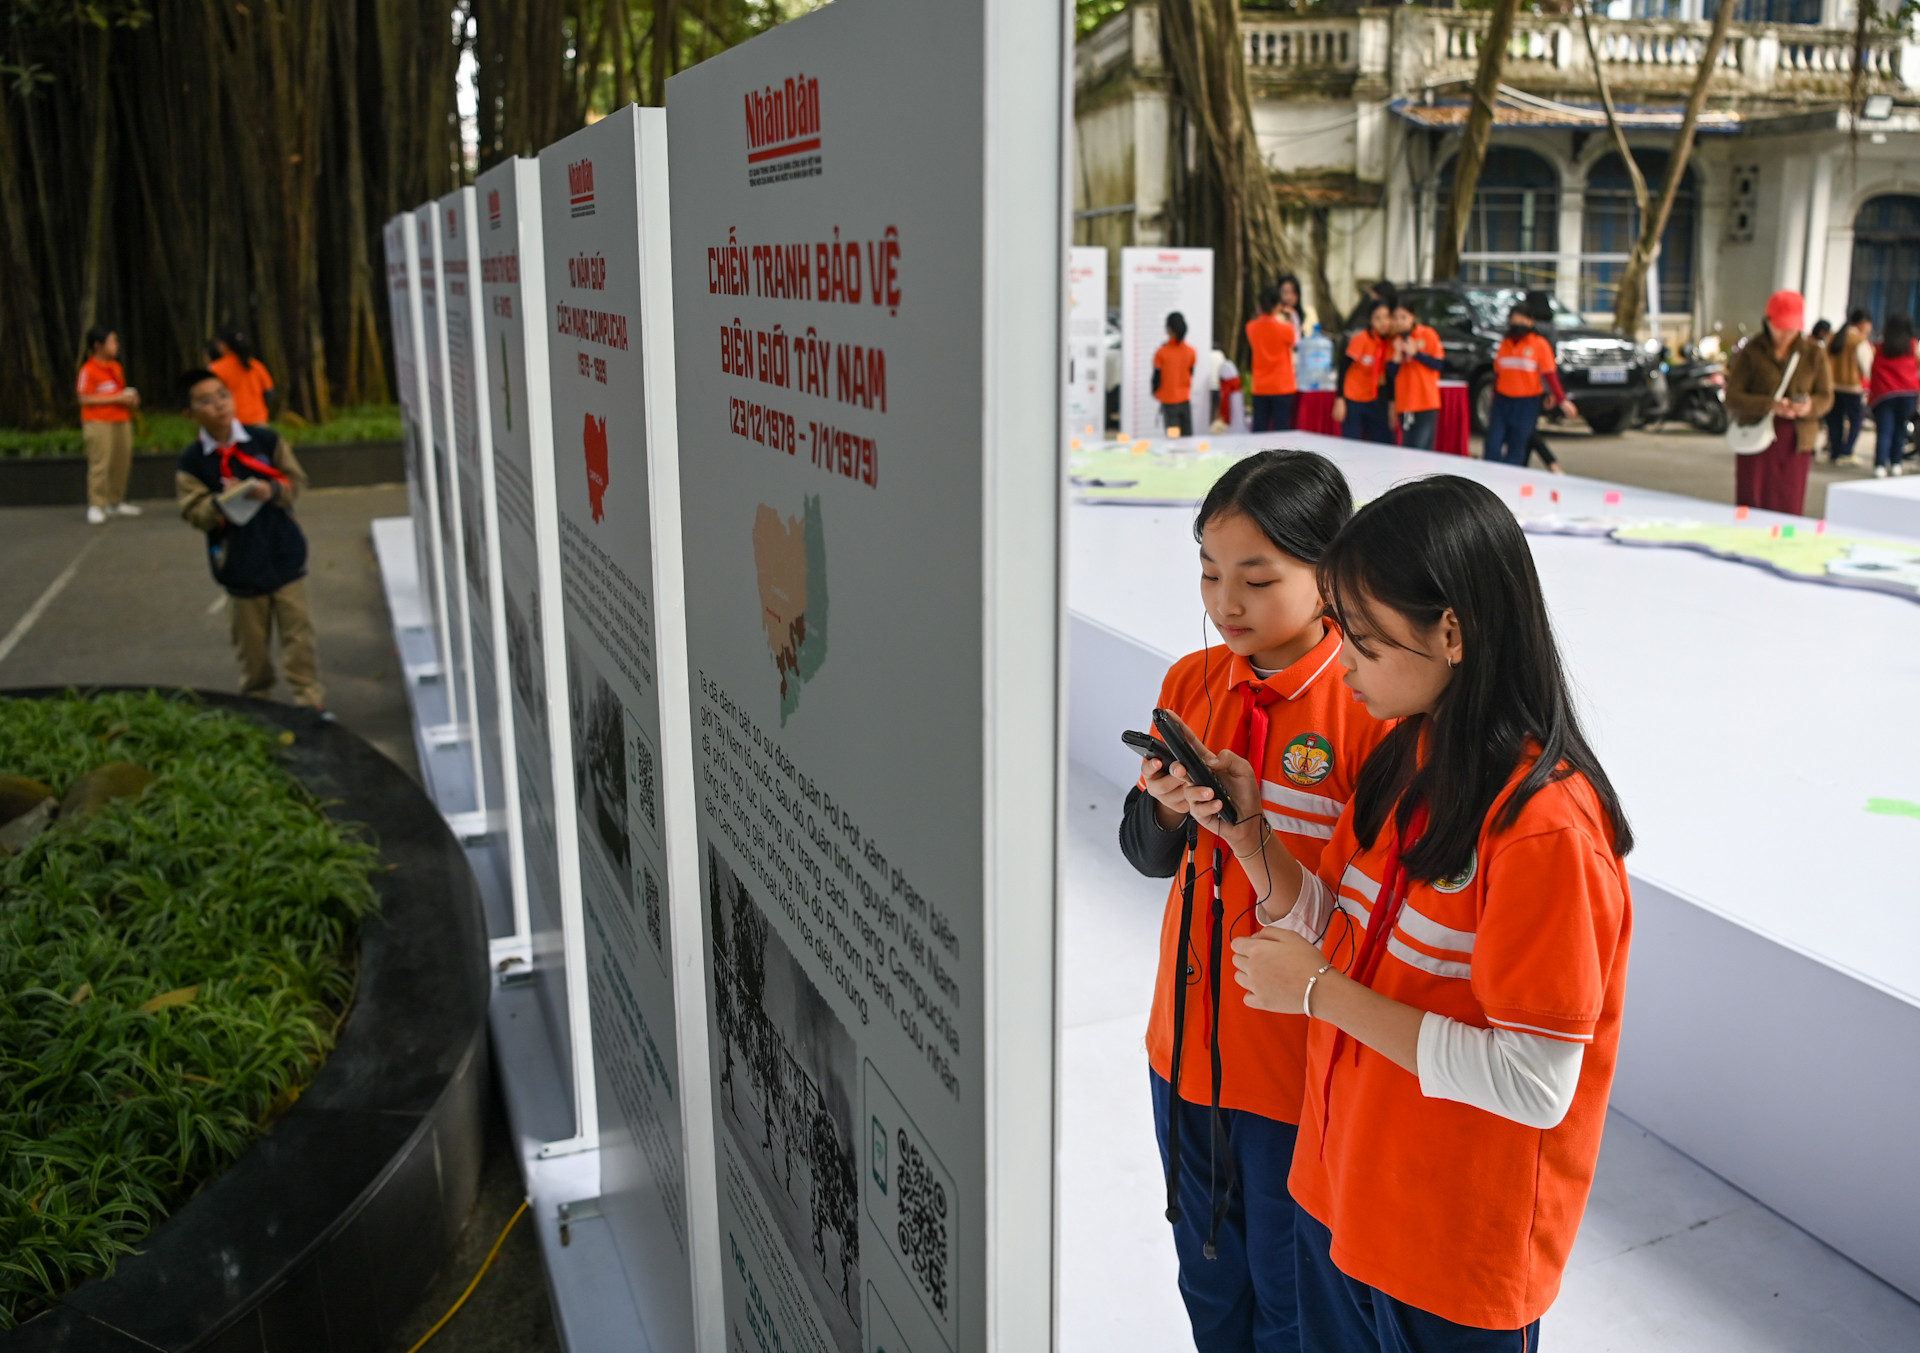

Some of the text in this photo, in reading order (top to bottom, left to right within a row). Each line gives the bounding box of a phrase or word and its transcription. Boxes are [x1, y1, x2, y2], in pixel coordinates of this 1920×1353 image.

[745, 73, 820, 150] Nhân Dân
[708, 224, 902, 318] CHIẾN TRANH BẢO VỆ
[720, 317, 887, 414] BIÊN GIỚI TÂY NAM
[729, 395, 796, 456] (23/12/1978
[808, 421, 878, 490] 7/1/1979)
[699, 669, 707, 694] Ta
[709, 680, 718, 704] đã
[720, 690, 737, 723] đánh
[739, 705, 751, 738] bật
[753, 725, 762, 746] 10
[764, 737, 773, 759] sư
[775, 745, 796, 784] đoàn
[798, 773, 821, 810] quân
[824, 792, 840, 830] Pol
[843, 811, 861, 853] Pot
[863, 838, 889, 881] xâm
[702, 733, 711, 756] đã
[713, 746, 728, 775] phối
[746, 777, 757, 808] lực
[784, 828, 795, 854] vũ
[798, 838, 822, 891] trang
[825, 877, 849, 919] cách
[853, 907, 885, 966] mạng
[889, 946, 960, 1056] Campuchia
[705, 793, 717, 823] dân
[718, 808, 757, 873] Campuchia
[758, 857, 778, 901] thoát
[713, 713, 726, 746] Tây
[726, 725, 743, 762] Nam
[776, 778, 791, 814] Sau
[807, 814, 832, 861] Quân
[834, 842, 854, 886] tình
[901, 913, 926, 968] Việt
[927, 946, 960, 1010] Nam
[732, 800, 751, 838] công
[752, 823, 766, 852] giải
[767, 841, 793, 891] phóng
[812, 895, 824, 925] đô
[827, 909, 863, 974] Phnom
[927, 1041, 960, 1102] nhân
[729, 1231, 747, 1284] THE
